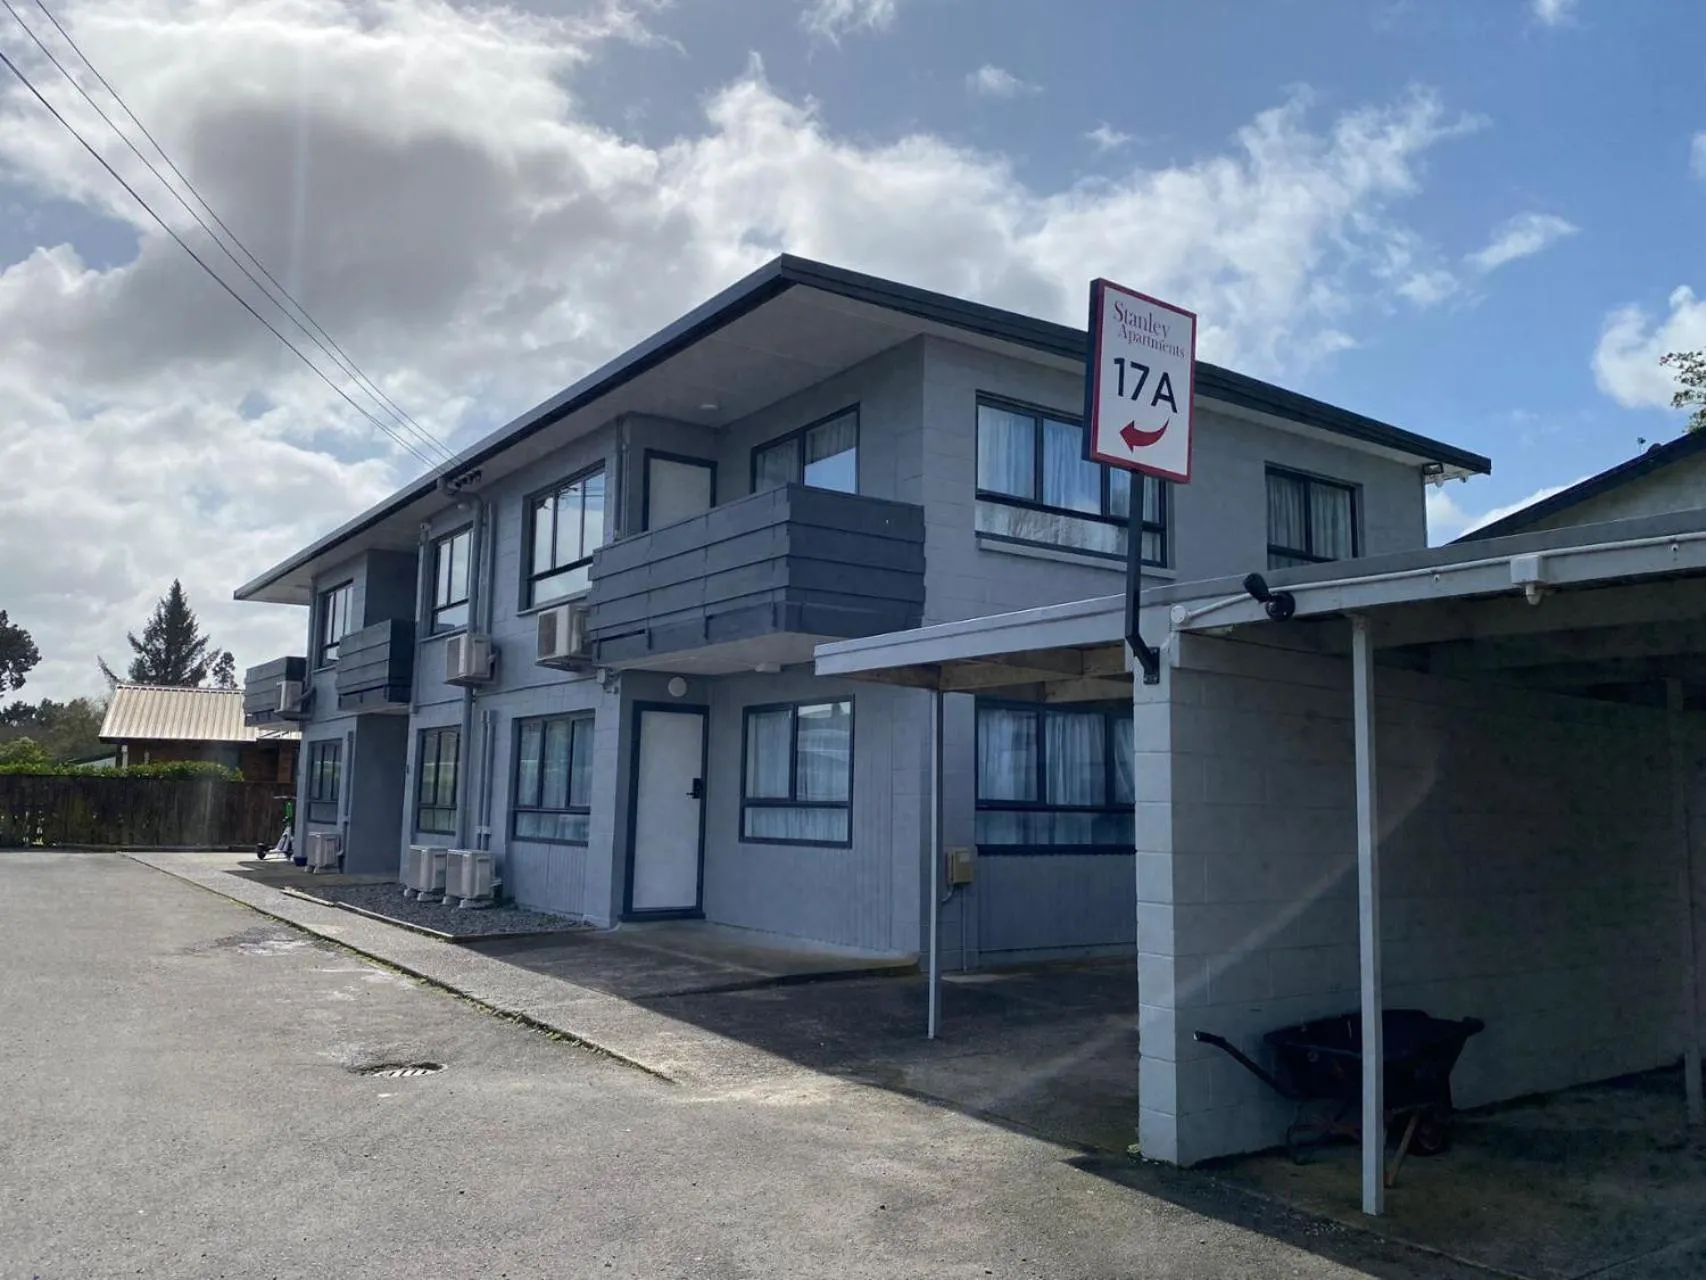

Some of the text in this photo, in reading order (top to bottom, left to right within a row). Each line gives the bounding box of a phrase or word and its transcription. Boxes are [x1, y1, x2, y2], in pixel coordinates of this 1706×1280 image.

[1113, 301, 1170, 339] Stanley
[1118, 324, 1185, 358] Apartments
[1114, 357, 1178, 414] 17A
